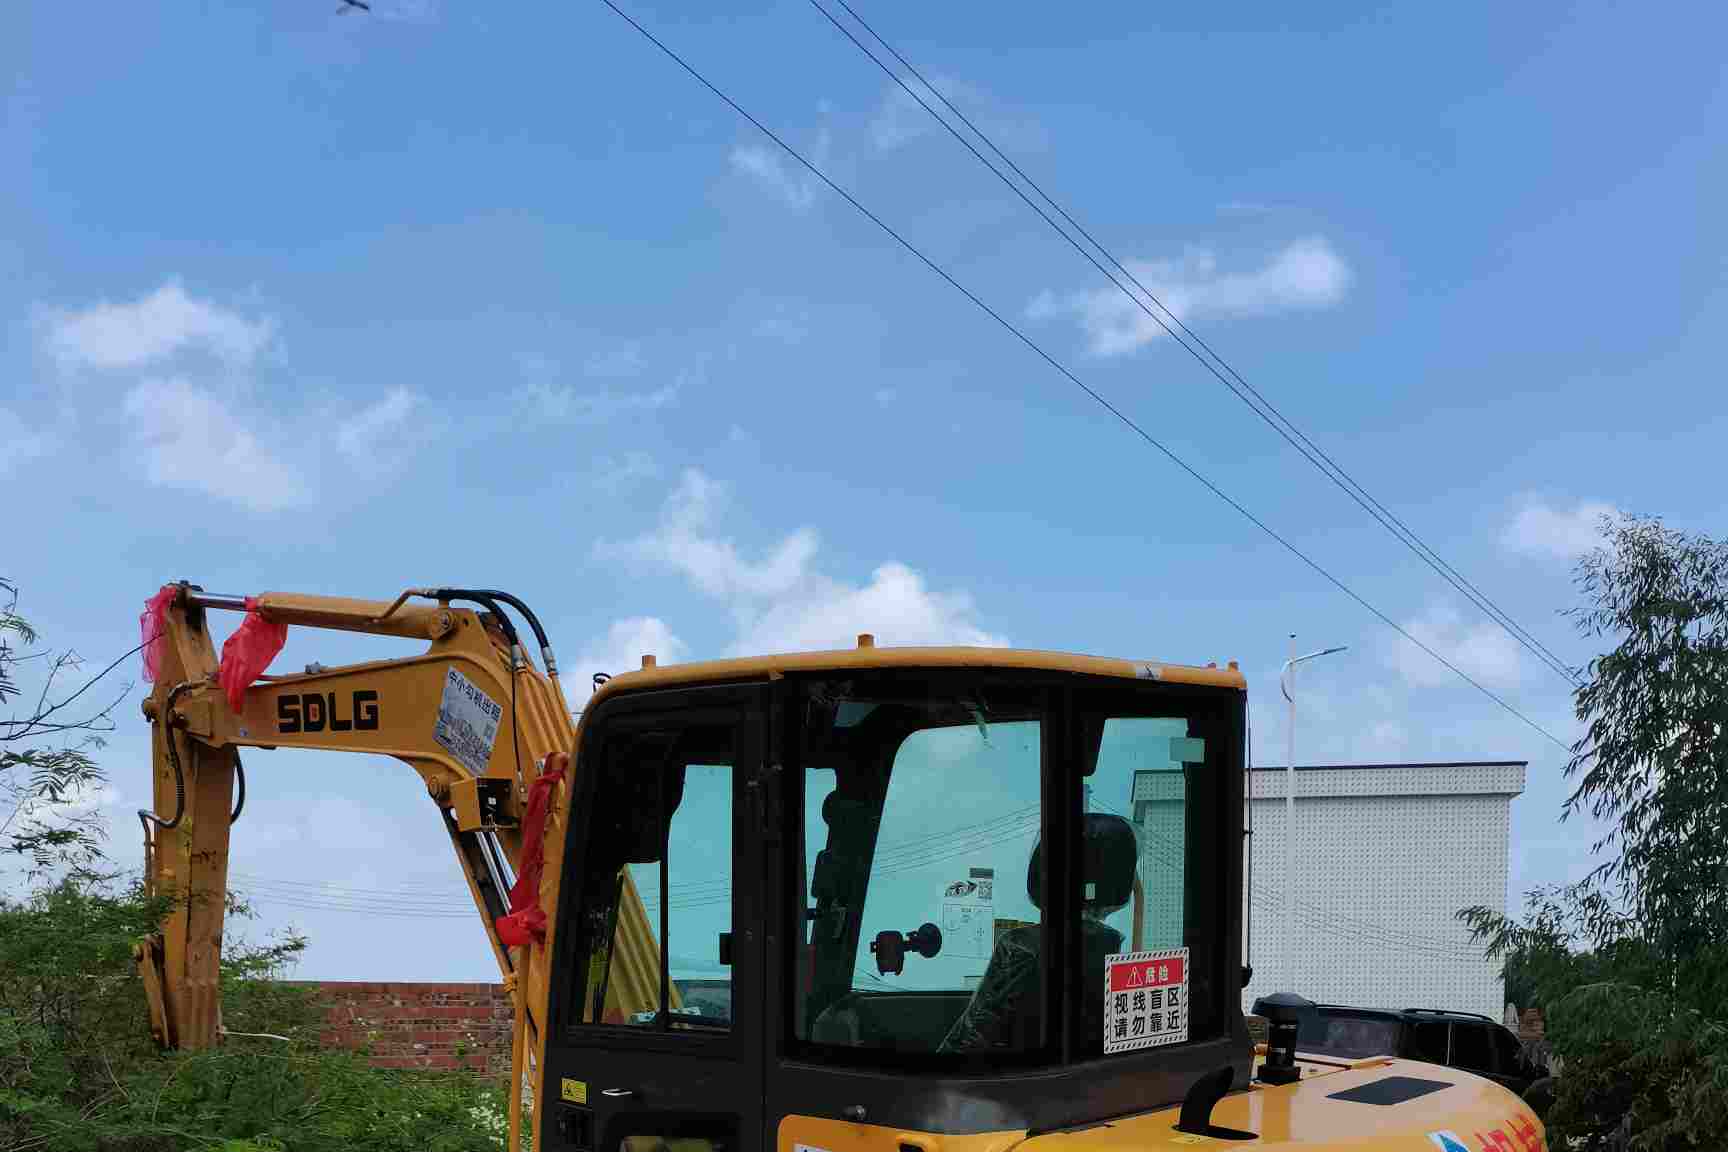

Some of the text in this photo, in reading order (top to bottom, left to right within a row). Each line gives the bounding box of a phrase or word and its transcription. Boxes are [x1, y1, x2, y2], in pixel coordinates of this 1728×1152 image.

[277, 689, 380, 734] SDLG
[1115, 986, 1180, 1017] 视线盲区
[1113, 1009, 1180, 1038] 请勿靠近
